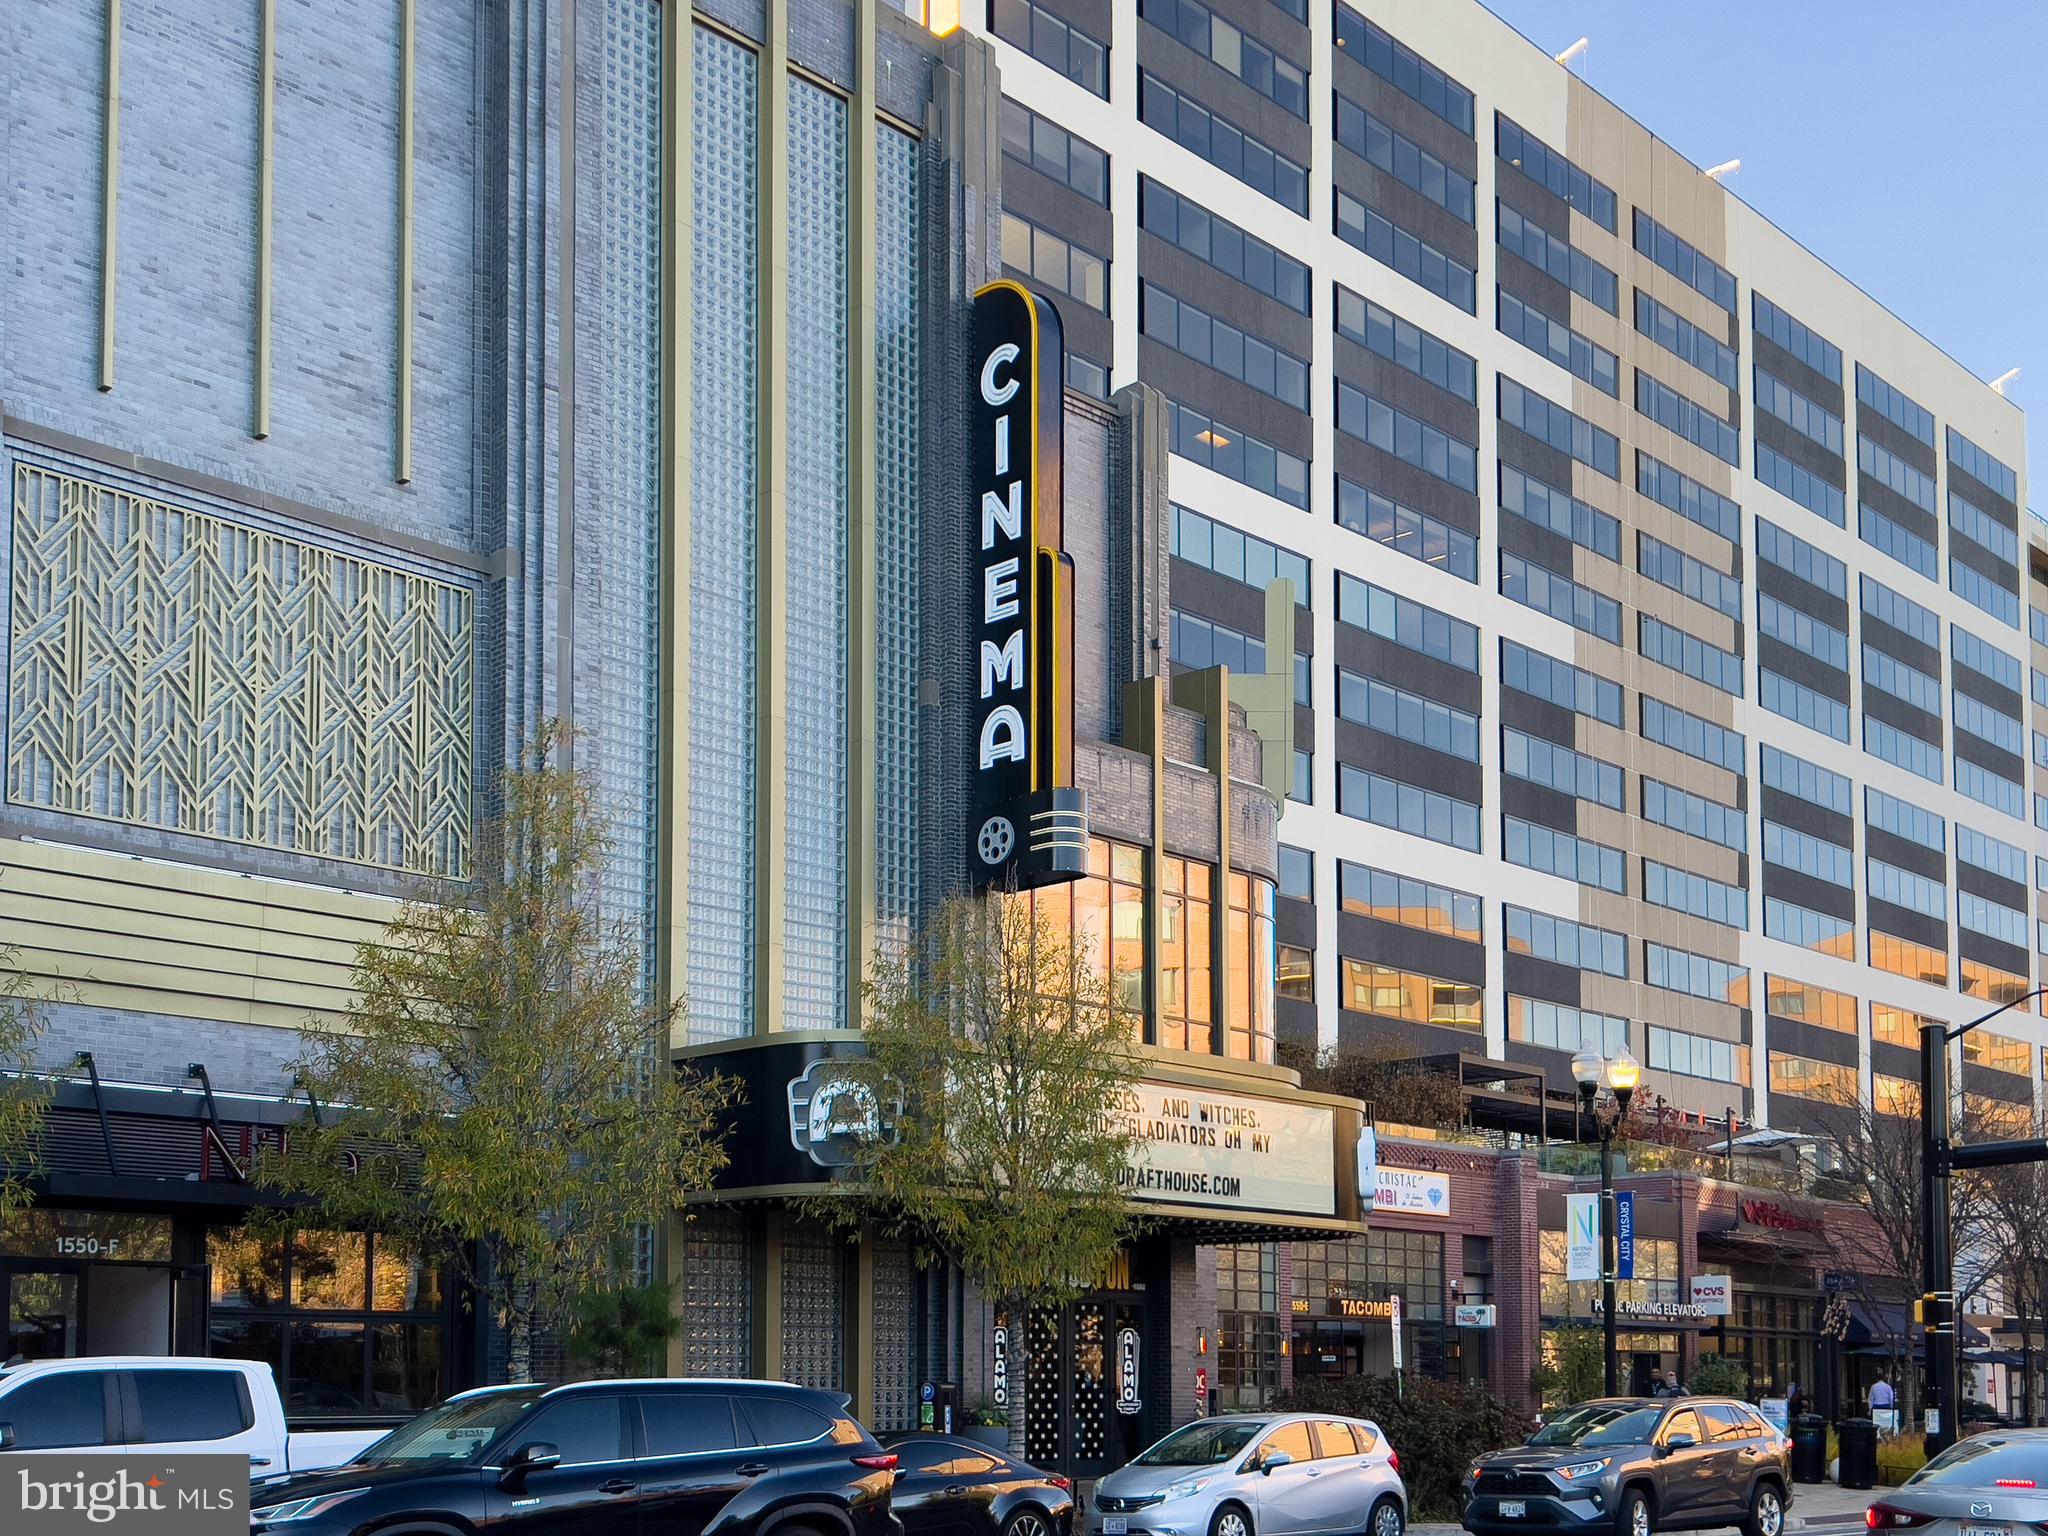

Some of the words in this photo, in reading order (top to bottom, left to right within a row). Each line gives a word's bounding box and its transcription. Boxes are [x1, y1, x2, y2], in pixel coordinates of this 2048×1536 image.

[980, 343, 1025, 771] CINEMA
[1162, 1098, 1189, 1118] AND
[1128, 1118, 1216, 1147] GLADIATORS
[1225, 1130, 1241, 1149] OH
[1252, 1133, 1271, 1153] MY
[1620, 1201, 1630, 1239] CRYSTAL
[56, 1236, 120, 1254] 1550-F
[1620, 1241, 1631, 1261] CITY
[1703, 1286, 1724, 1296] CVS
[1341, 1299, 1393, 1316] TACOMB
[1626, 1301, 1662, 1315] PARKING
[1663, 1303, 1707, 1317] ELEVATORS
[994, 1330, 1006, 1403] ALAMO
[1123, 1331, 1135, 1401] ALAMO
